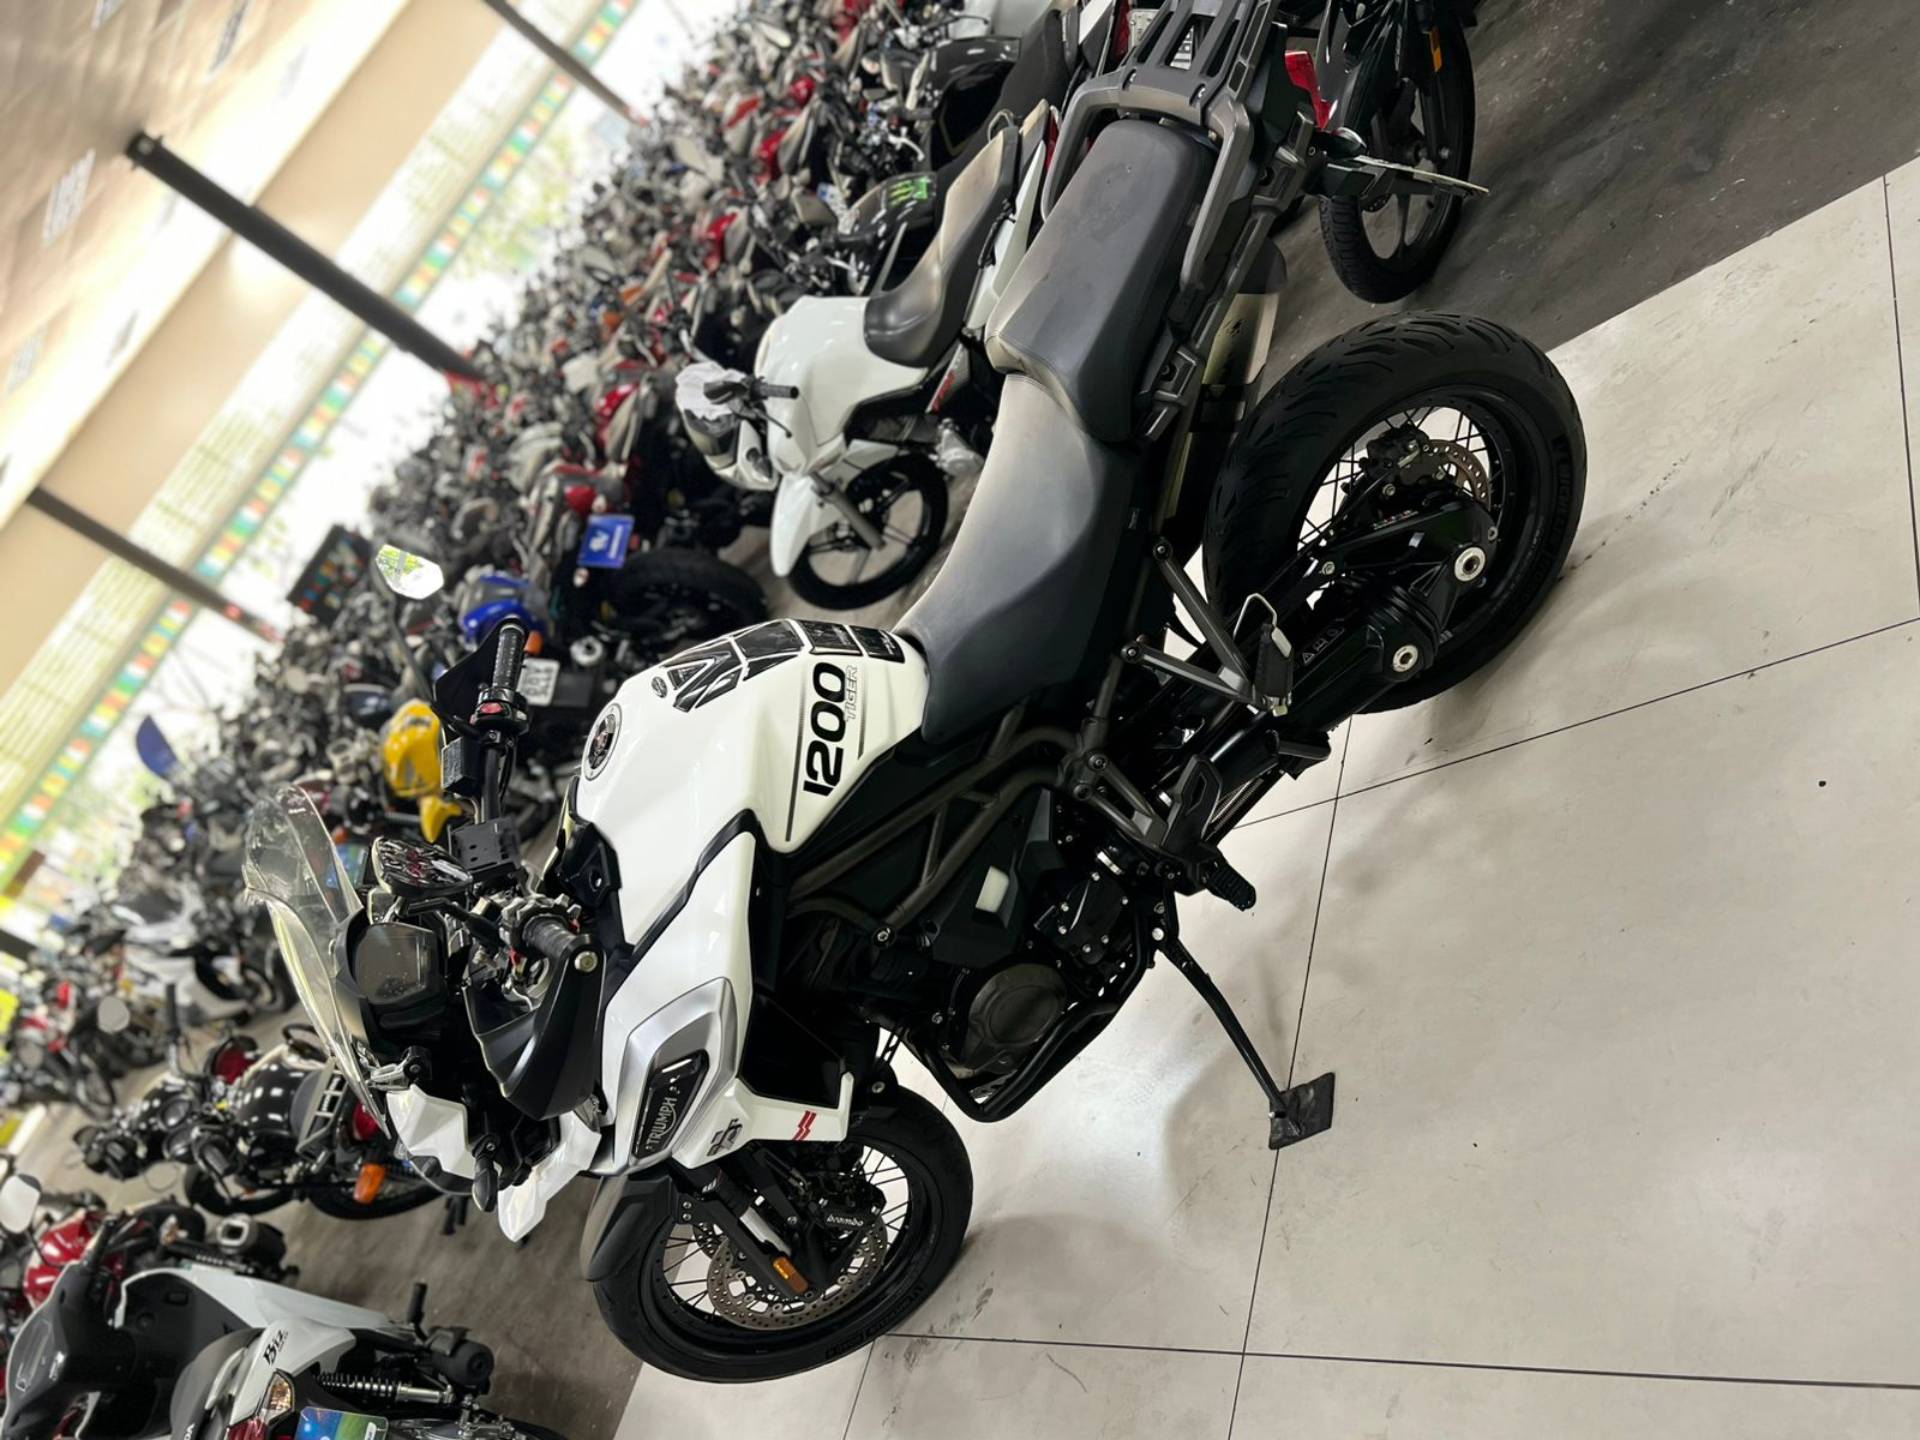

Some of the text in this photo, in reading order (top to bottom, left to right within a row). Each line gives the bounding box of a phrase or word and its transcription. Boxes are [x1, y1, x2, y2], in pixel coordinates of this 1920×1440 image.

[803, 662, 846, 797] 1200
[649, 1097, 678, 1146] TRIUMPH
[263, 1329, 285, 1365] Biz
